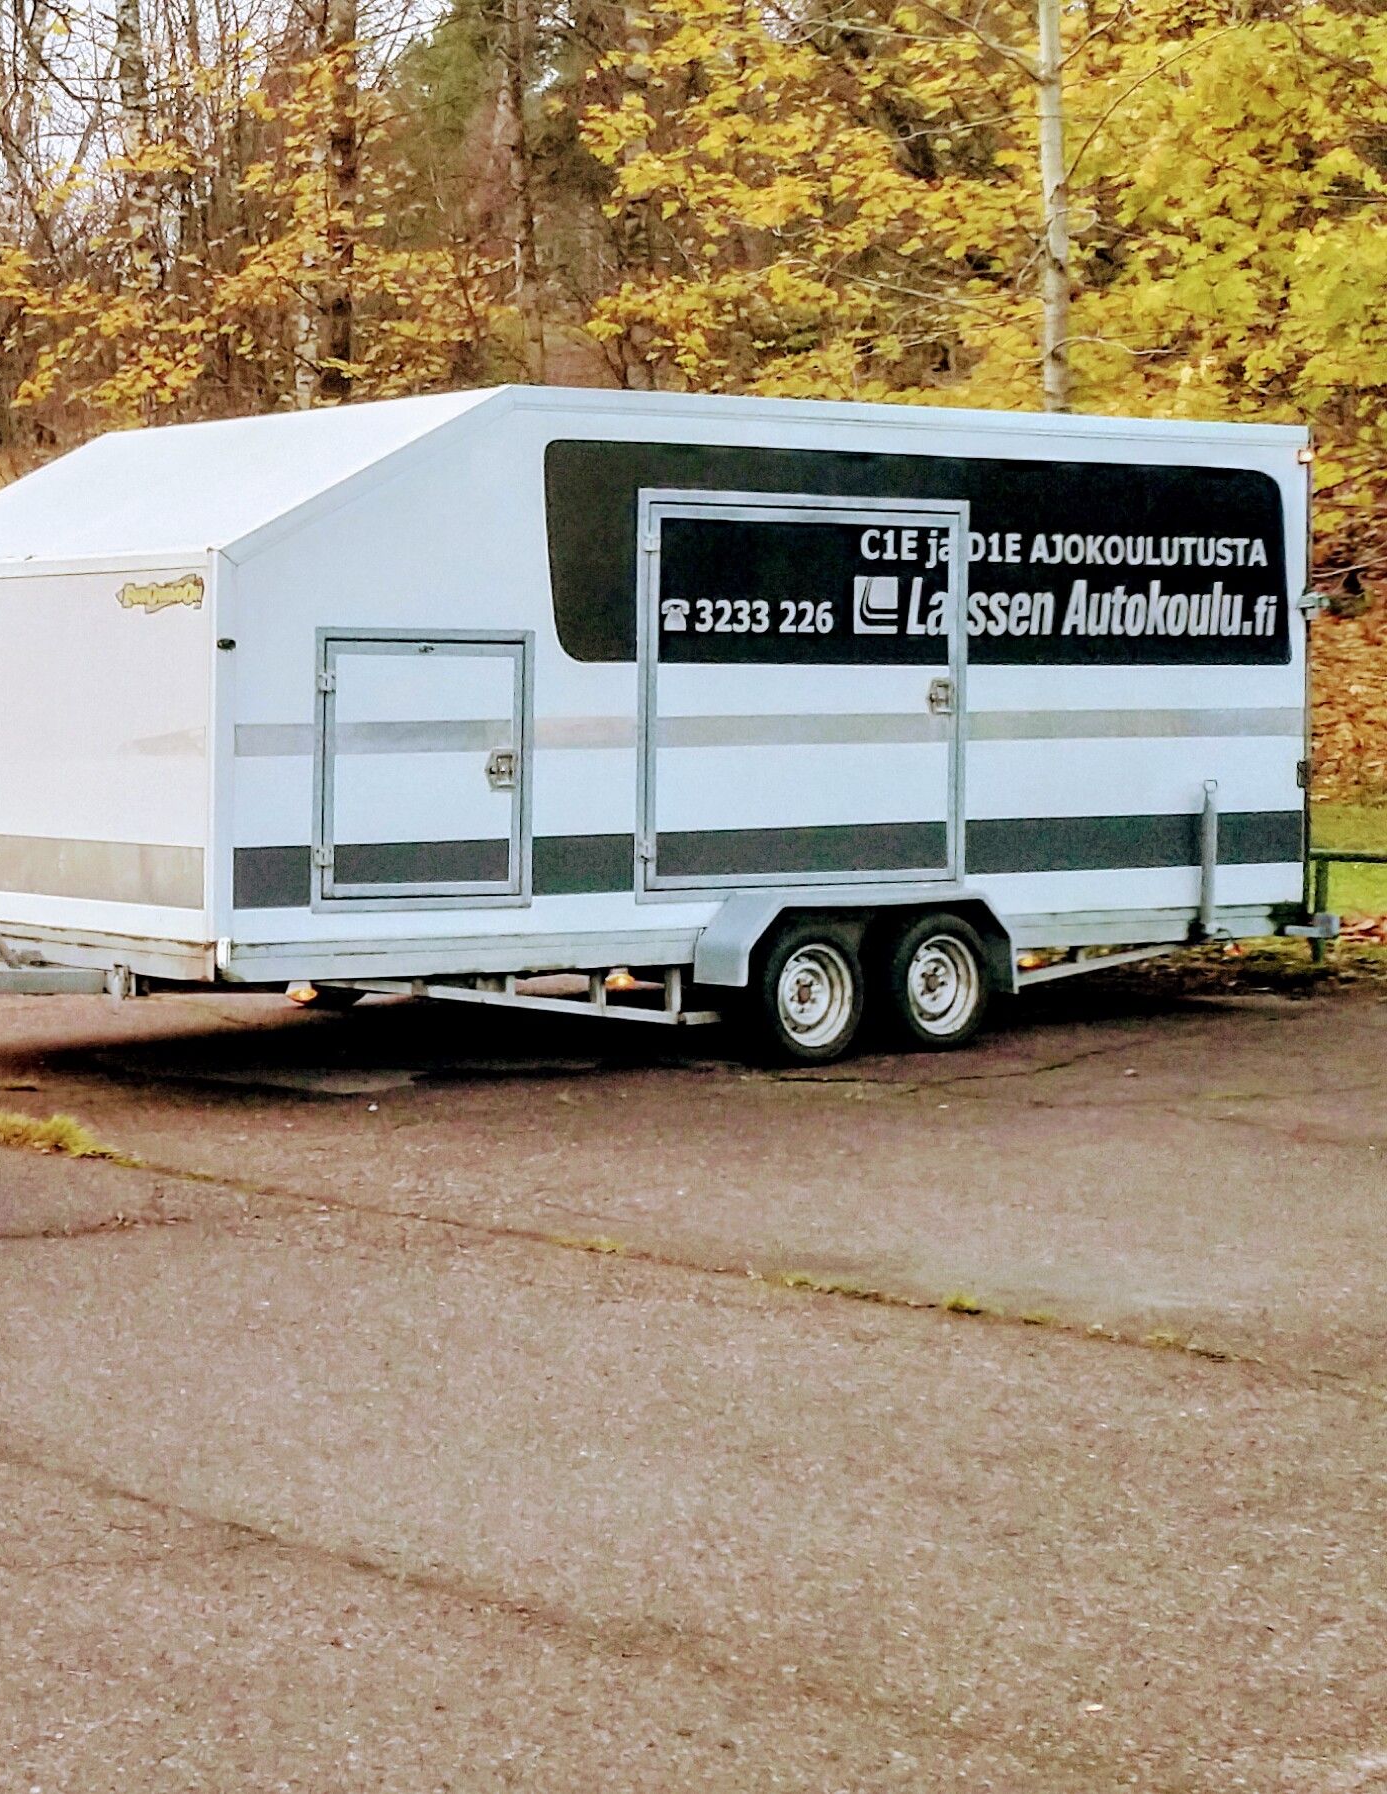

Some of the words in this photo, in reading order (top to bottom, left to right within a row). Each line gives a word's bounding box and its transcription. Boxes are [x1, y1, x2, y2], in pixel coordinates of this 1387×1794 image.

[860, 529, 919, 561] C1E
[925, 529, 951, 569] ja
[965, 531, 1022, 563] D1E
[1029, 533, 1268, 567] AJOKOULUTUSTA
[695, 599, 770, 633] 3233
[779, 600, 834, 634] 226
[906, 576, 1055, 636] Lassen
[1061, 579, 1278, 636] Autokoulu.fi
